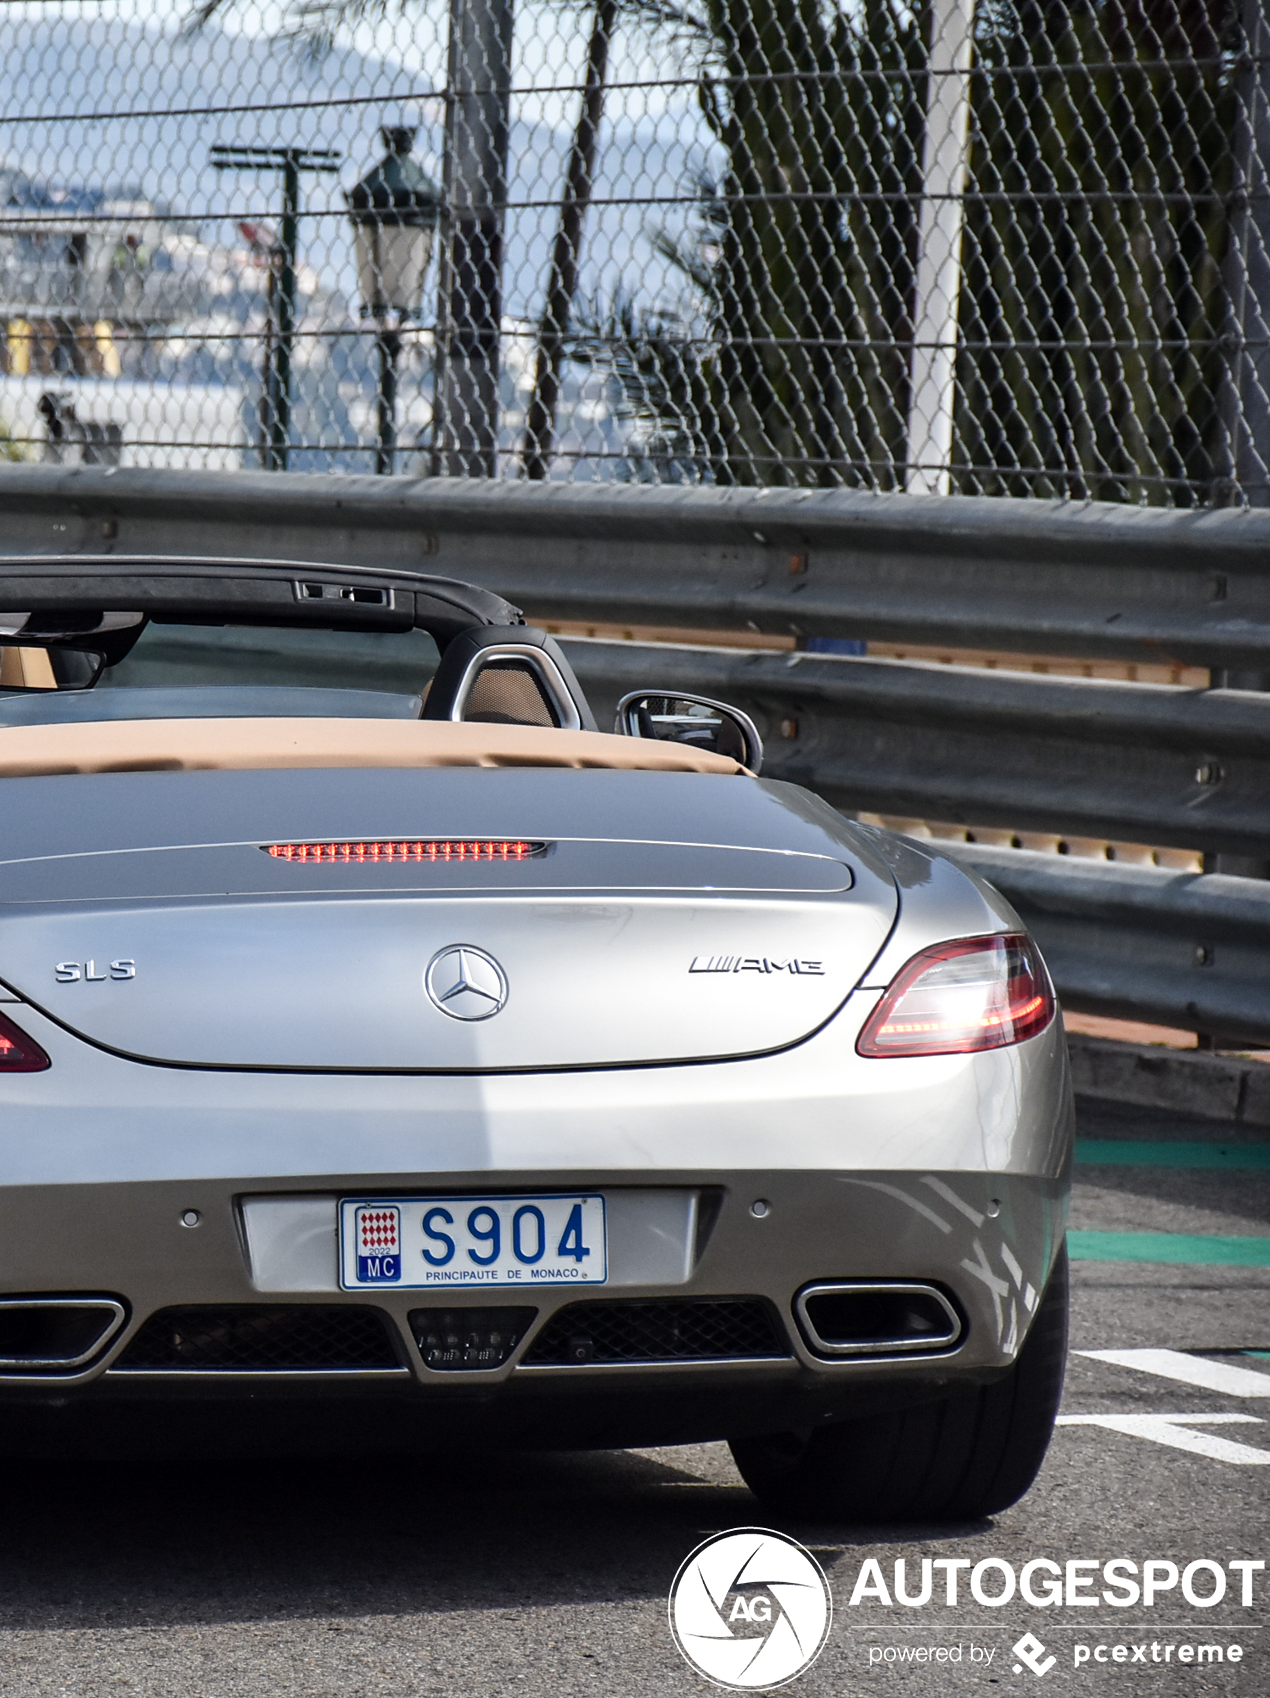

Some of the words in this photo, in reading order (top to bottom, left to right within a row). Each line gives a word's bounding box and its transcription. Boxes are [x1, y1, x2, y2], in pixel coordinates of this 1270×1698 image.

[55, 959, 136, 983] SLS
[733, 956, 826, 976] AMG
[422, 1204, 590, 1267] S904
[369, 1247, 391, 1256] 2022
[367, 1257, 395, 1277] MC
[426, 1270, 498, 1281] PRINCIPAUTE
[507, 1269, 522, 1279] DE
[531, 1268, 579, 1279] MONACO
